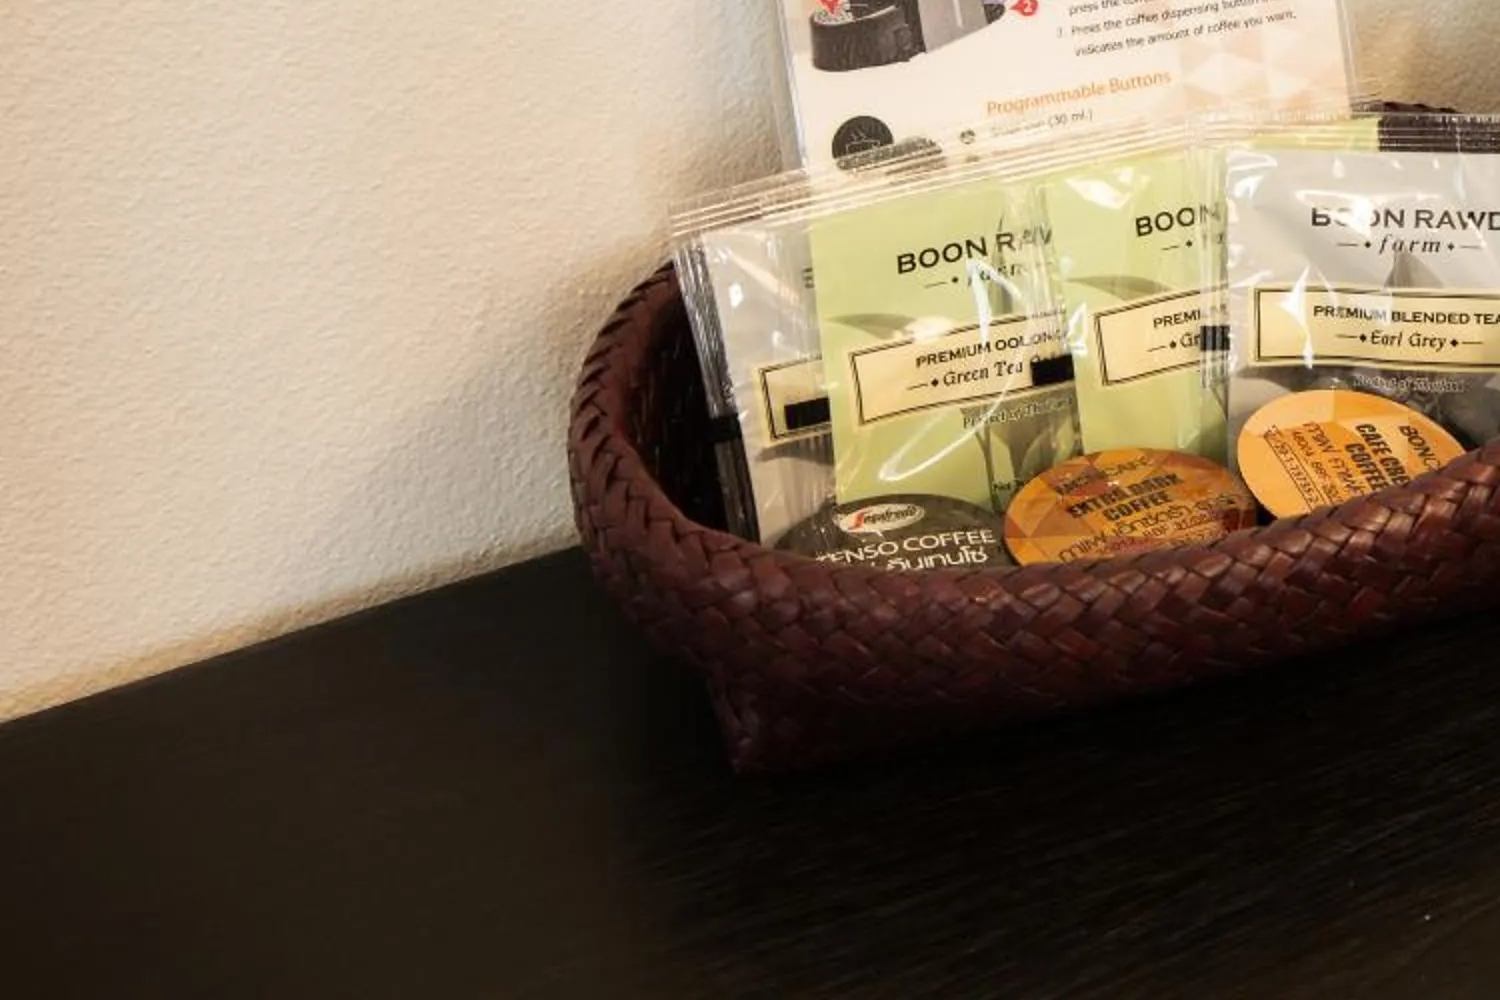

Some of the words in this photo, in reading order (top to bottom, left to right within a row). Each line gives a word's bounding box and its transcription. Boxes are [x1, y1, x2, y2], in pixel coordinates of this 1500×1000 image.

[986, 81, 1104, 115] Programmable
[1108, 69, 1171, 94] Buttons
[1311, 207, 1405, 230] BON
[896, 236, 988, 275] BOON
[1379, 234, 1441, 254] farm
[1313, 305, 1387, 322] PREMIUM
[1391, 310, 1470, 325] BLENDED
[915, 340, 990, 368] PREMIUM
[1370, 330, 1401, 347] Earl
[1409, 333, 1446, 352] Grey
[943, 367, 988, 387] Green
[993, 359, 1022, 377] Tea
[1355, 423, 1393, 457] CAFE
[1102, 491, 1171, 521] COFFEE
[903, 529, 997, 550] COFFEE
